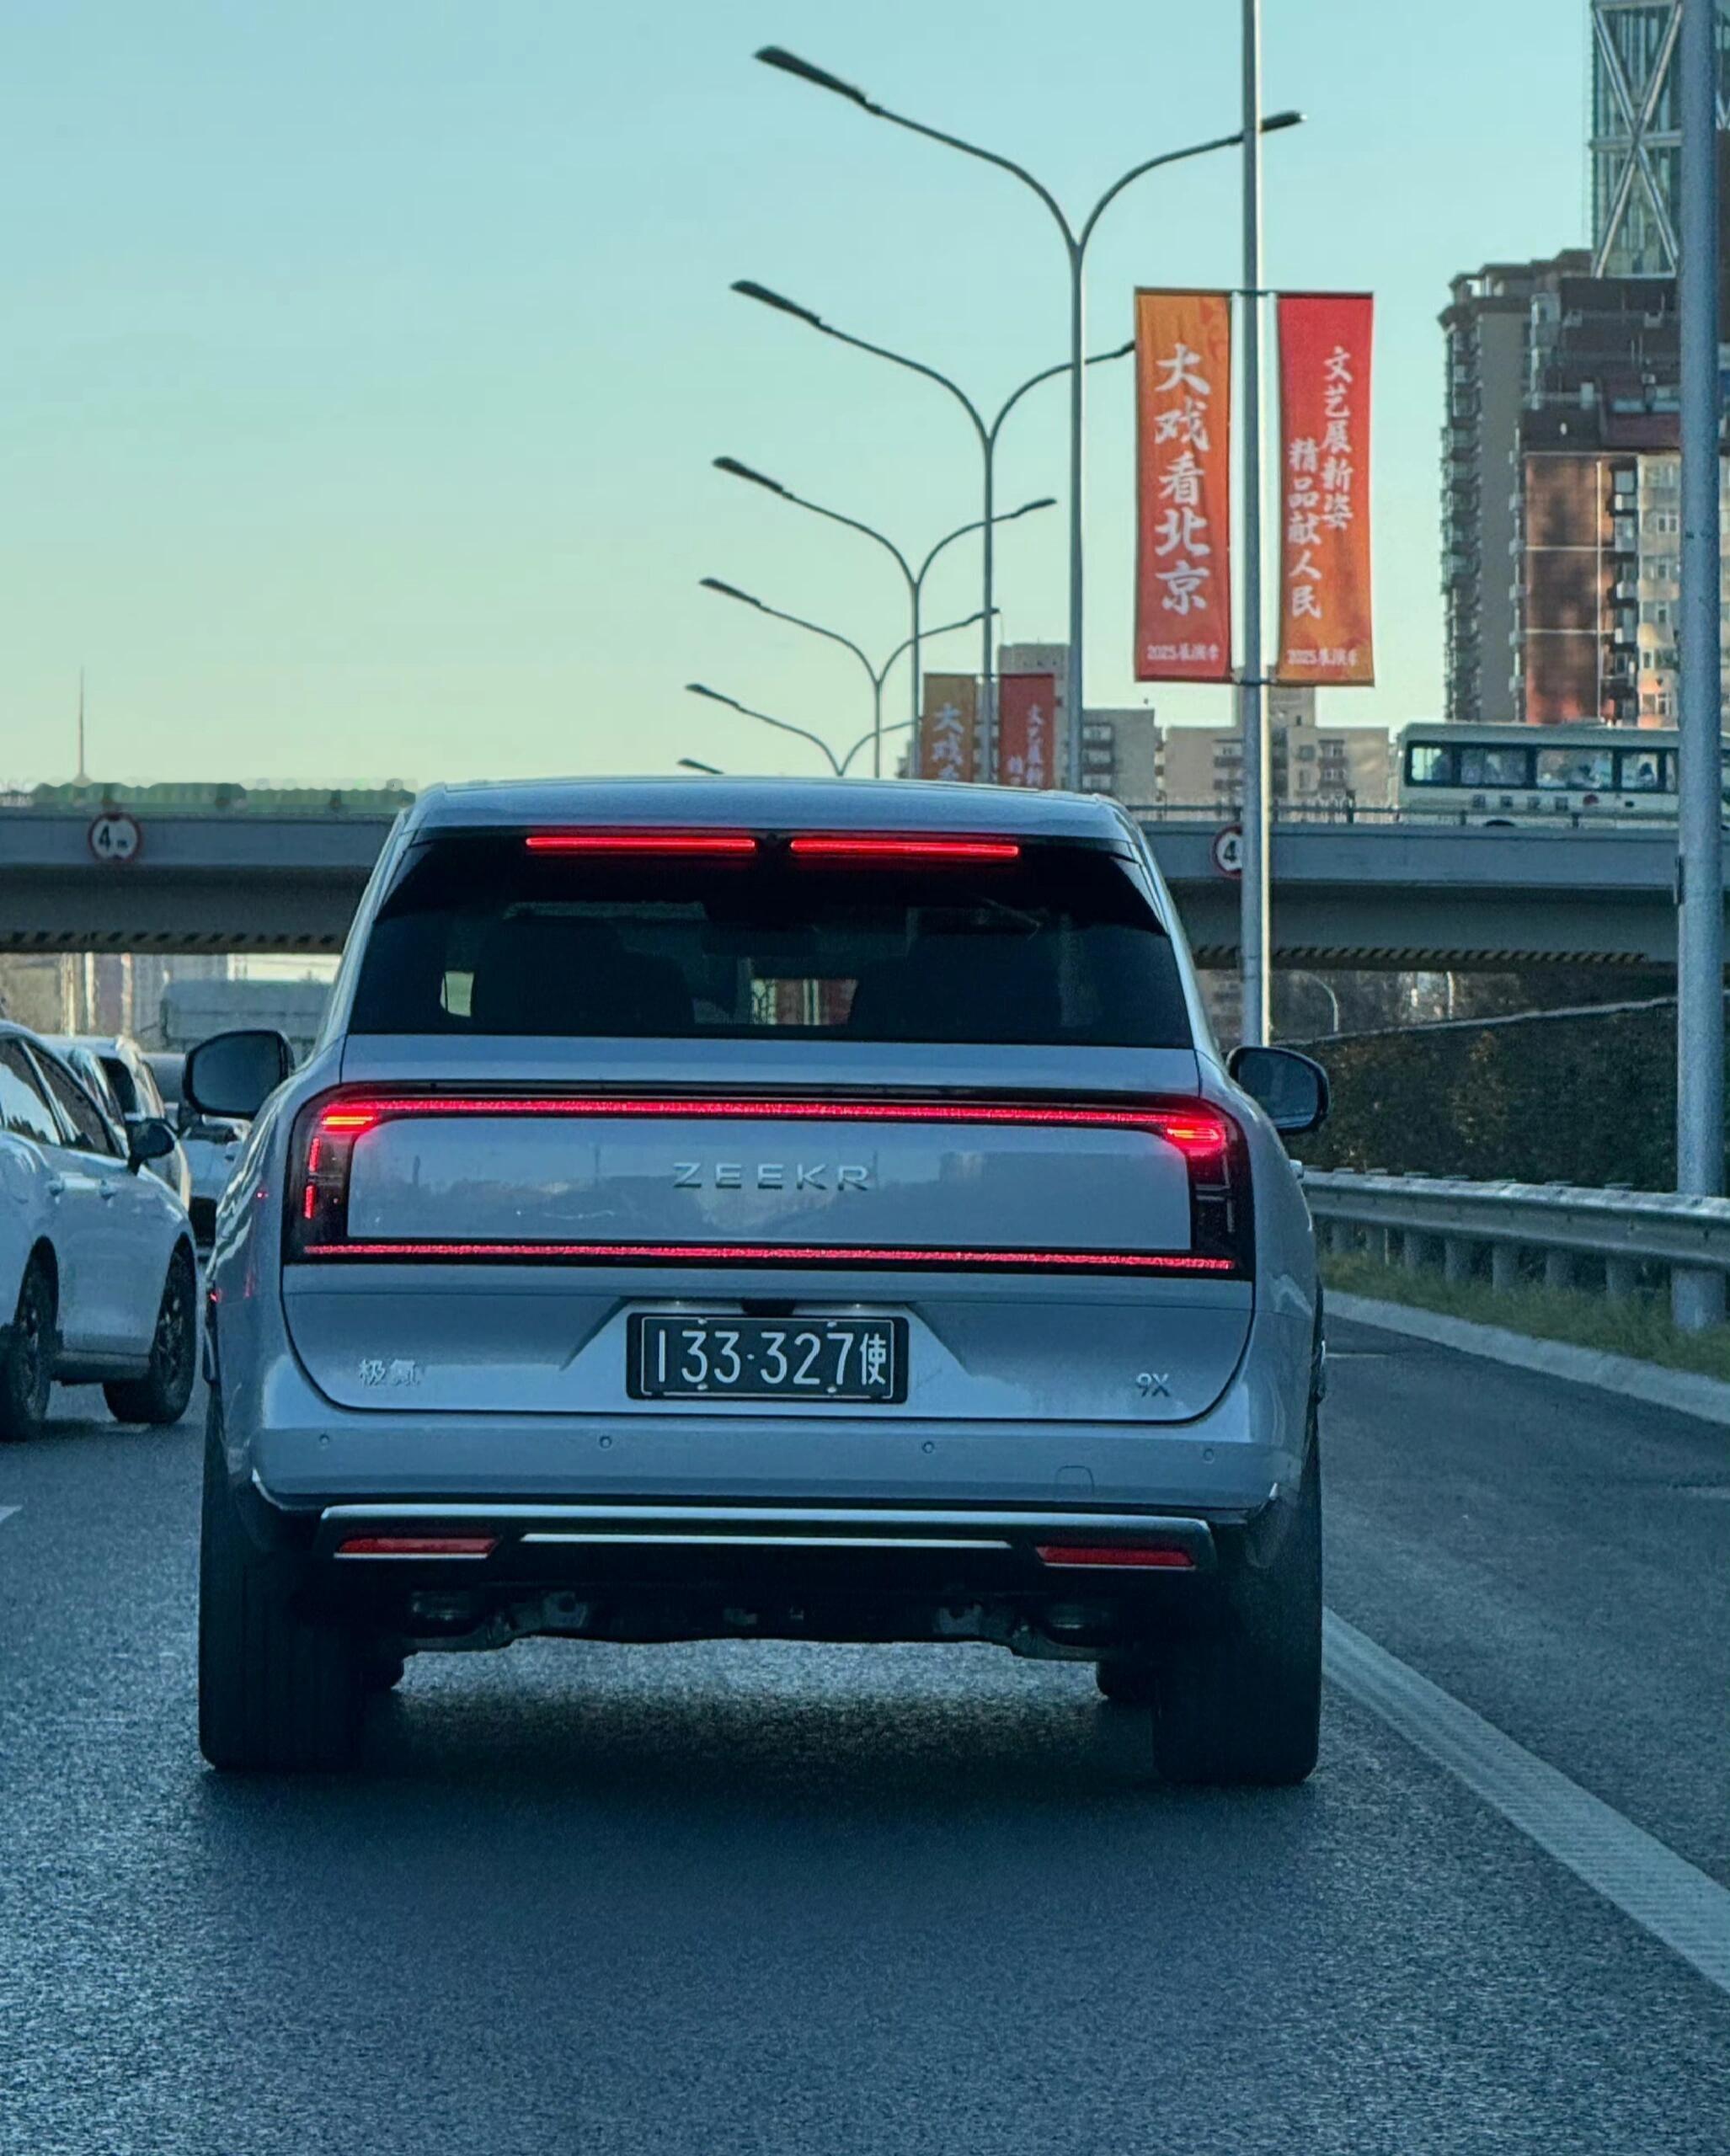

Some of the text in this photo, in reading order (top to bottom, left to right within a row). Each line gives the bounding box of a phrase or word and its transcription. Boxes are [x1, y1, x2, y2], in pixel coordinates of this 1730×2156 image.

[1155, 343, 1210, 616] 大戏看北京
[1289, 437, 1322, 619] 精品献人民
[1320, 345, 1354, 530] 文艺展新姿
[673, 1162, 868, 1191] ZEEKR
[1135, 1373, 1171, 1397] 9X
